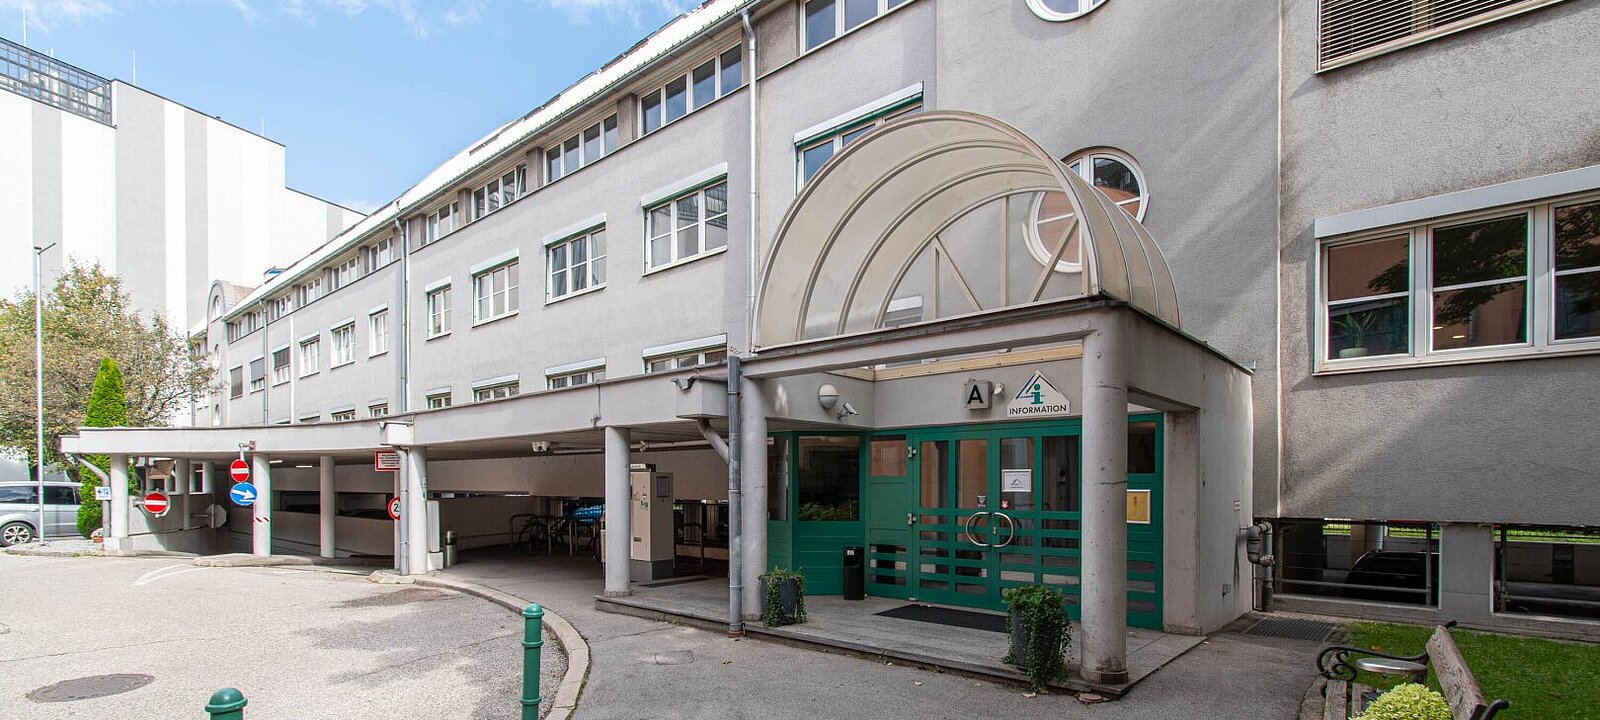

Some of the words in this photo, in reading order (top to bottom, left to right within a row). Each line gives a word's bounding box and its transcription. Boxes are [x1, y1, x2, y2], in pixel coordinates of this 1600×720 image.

[967, 385, 984, 405] A
[1031, 383, 1044, 405] i
[1009, 405, 1067, 415] INFORMATION
[393, 503, 400, 512] 2
